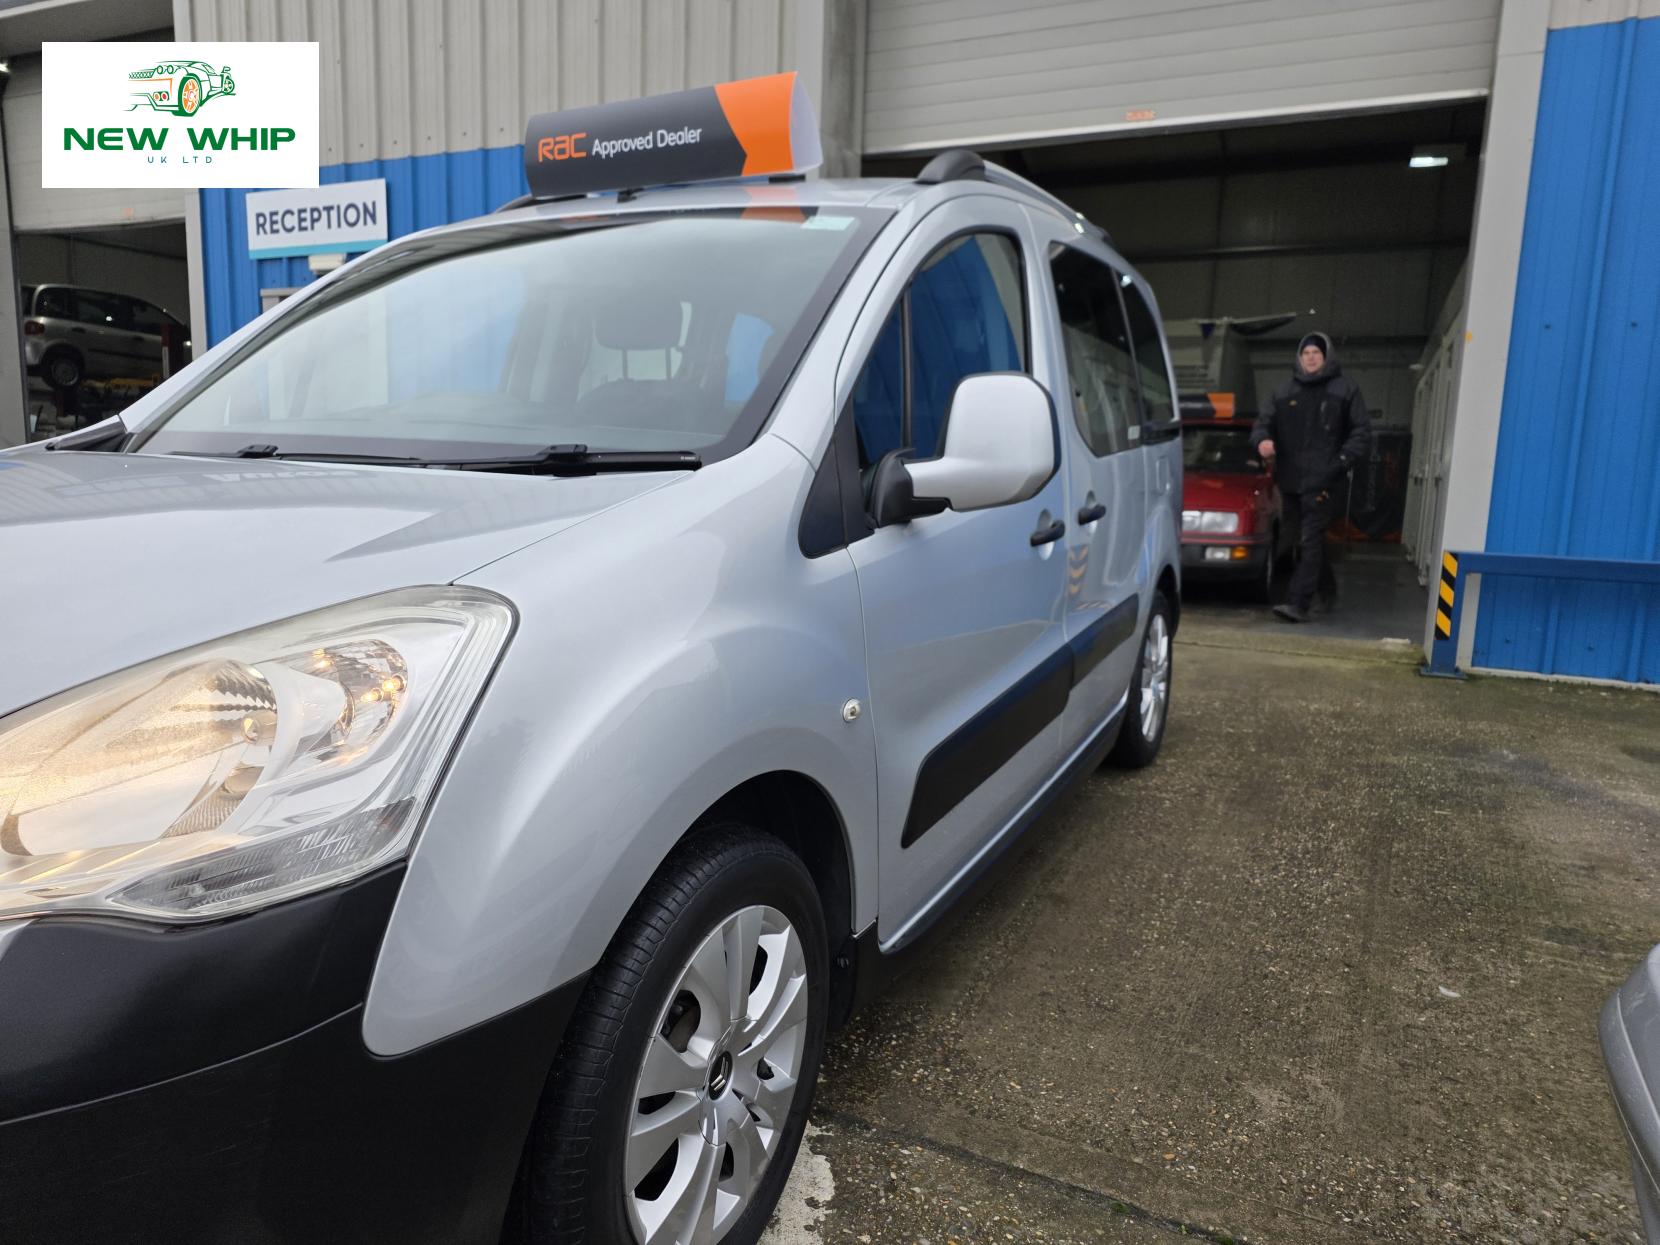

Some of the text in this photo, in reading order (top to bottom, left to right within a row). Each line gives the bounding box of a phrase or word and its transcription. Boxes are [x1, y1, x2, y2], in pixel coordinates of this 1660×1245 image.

[592, 131, 653, 159] Approved
[656, 126, 702, 148] Dealer
[255, 201, 377, 236] RECEPTION
